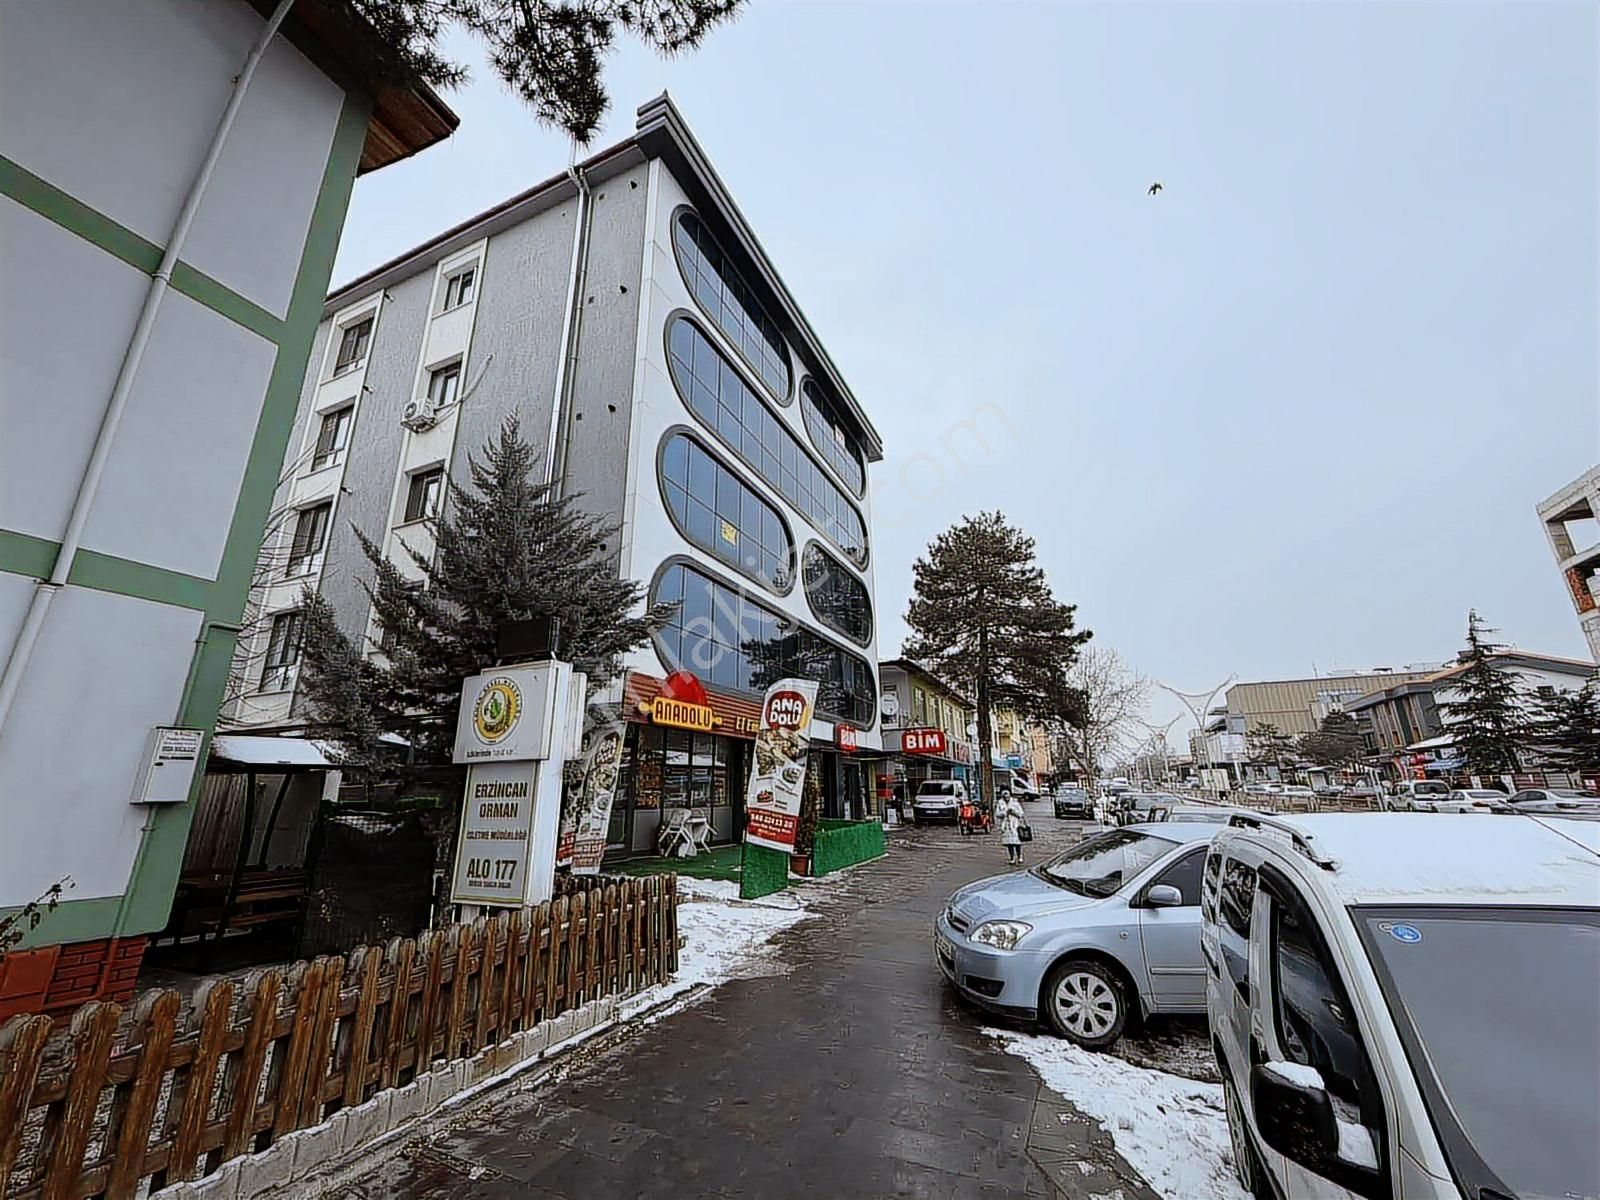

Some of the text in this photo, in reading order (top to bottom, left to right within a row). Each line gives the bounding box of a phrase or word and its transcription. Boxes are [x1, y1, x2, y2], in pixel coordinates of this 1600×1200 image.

[654, 700, 711, 727] ANADOLU
[771, 697, 803, 714] ANA
[769, 711, 802, 726] DOLU
[906, 731, 940, 749] BİM
[475, 780, 528, 798] ERZİNCAN
[479, 802, 519, 819] ORMAN
[466, 858, 518, 881] ALO 177
